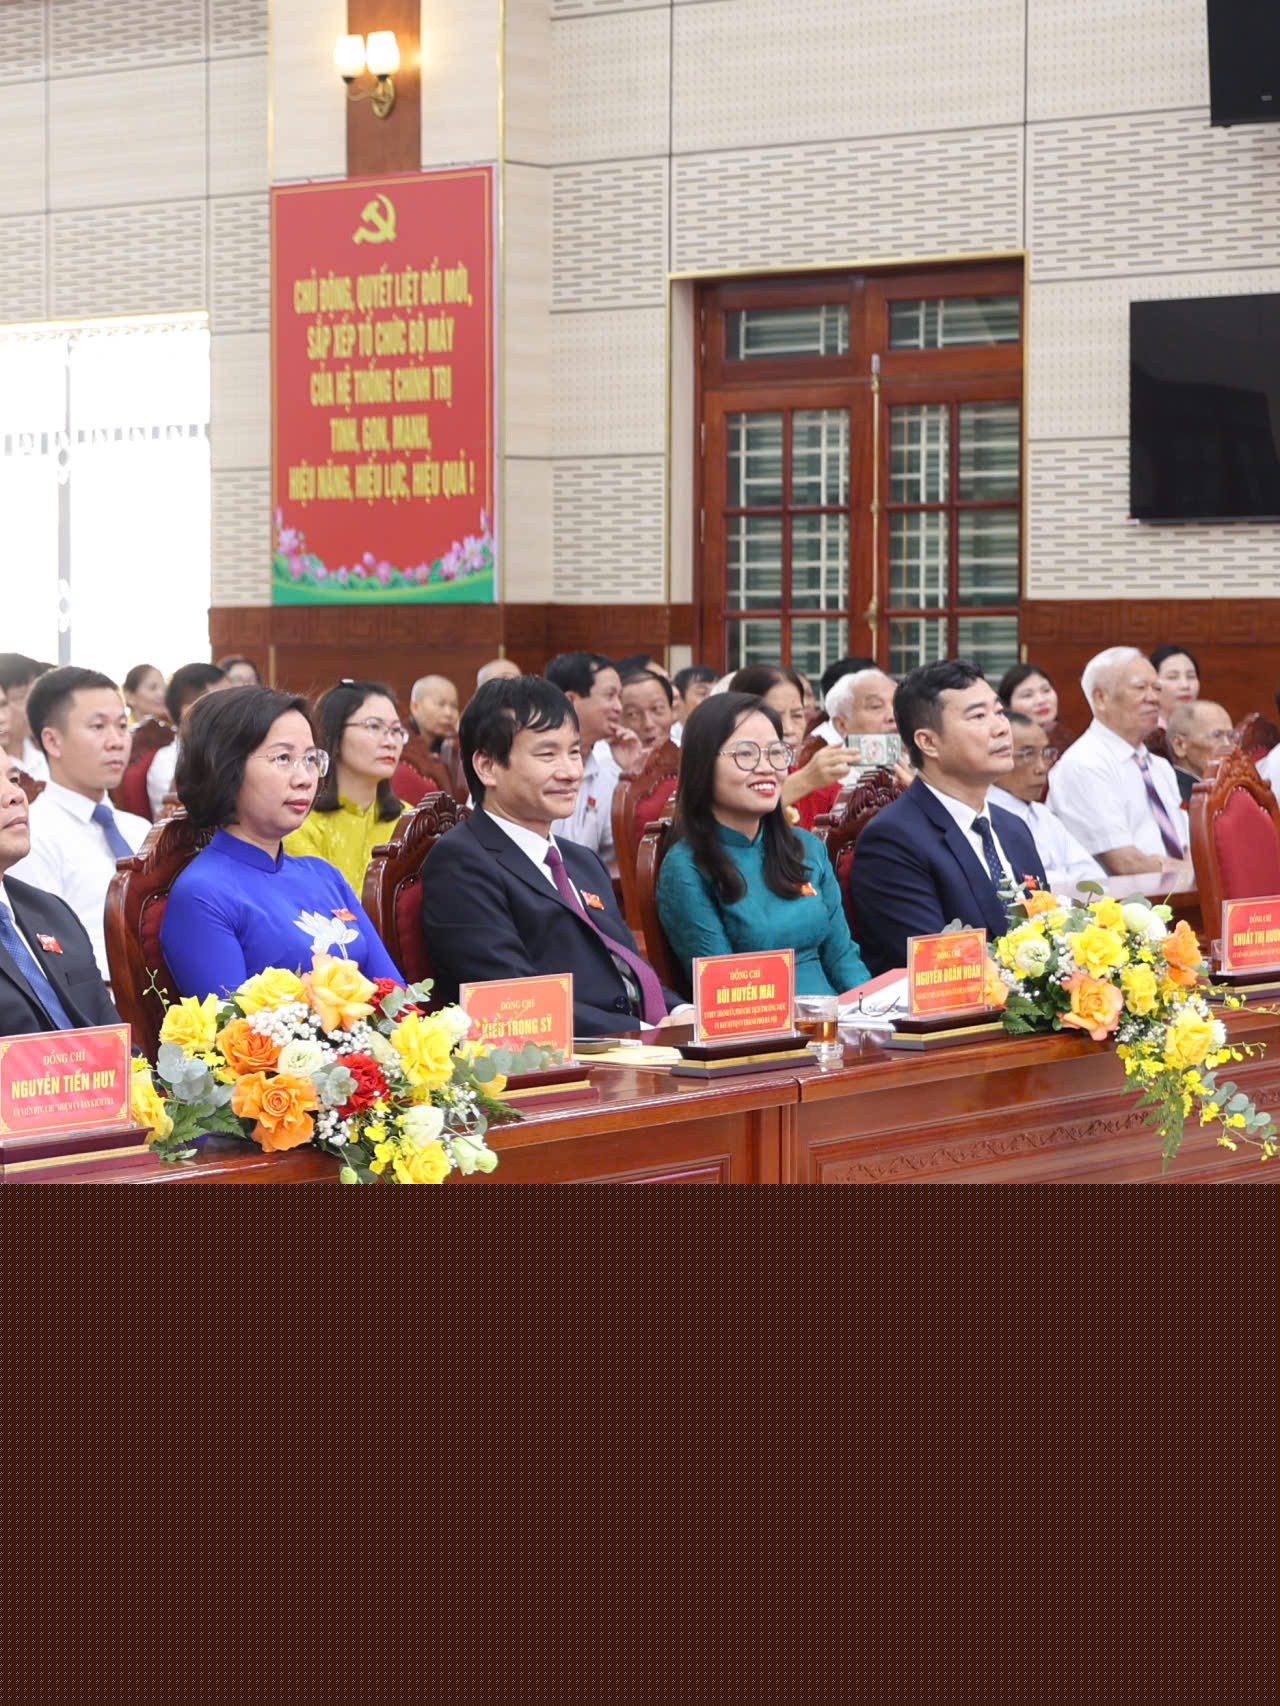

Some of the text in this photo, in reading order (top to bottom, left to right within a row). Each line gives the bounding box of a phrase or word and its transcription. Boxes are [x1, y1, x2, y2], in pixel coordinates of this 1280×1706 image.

[294, 267, 318, 314] CHỦ
[356, 262, 393, 314] QUYẾT
[395, 264, 419, 314] LIỆT
[307, 310, 455, 361] SẮP XẾP TỔ CHỨC BỘ MÁY
[310, 357, 453, 413] CỦA HỆ THỐNG CHÍNH TRỊ
[288, 459, 316, 508] HIỆU
[355, 456, 382, 506] HIỆU
[412, 454, 440, 504] HIỆU
[716, 985, 730, 1004] BÙI
[759, 984, 775, 1000] MAI
[43, 1048, 86, 1066] ĐỒNG CHÍ
[11, 1067, 116, 1100] NGUYỄN TIẾN HUY
